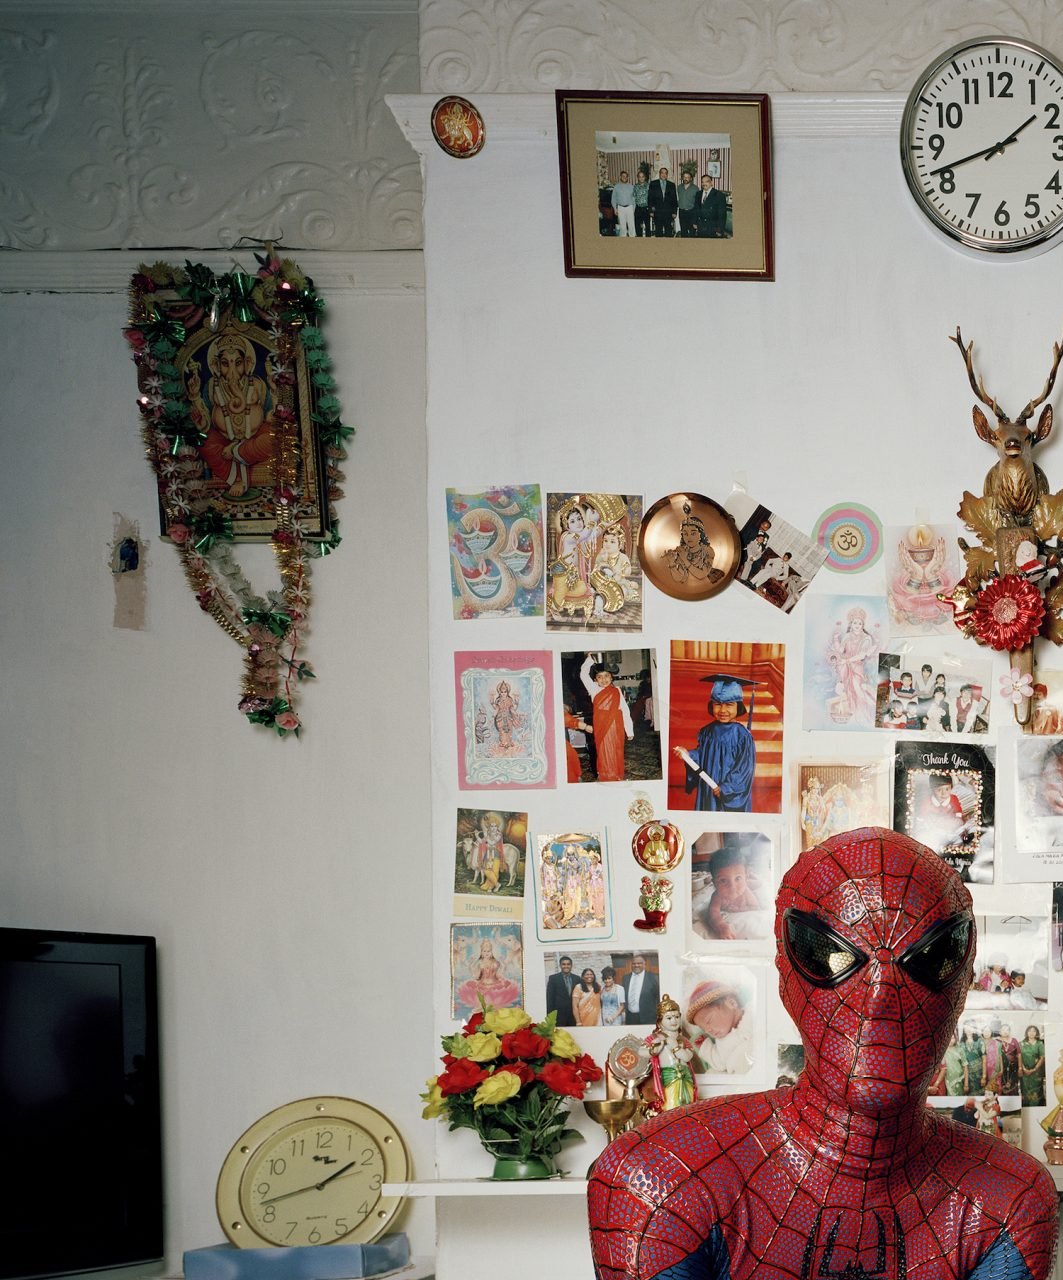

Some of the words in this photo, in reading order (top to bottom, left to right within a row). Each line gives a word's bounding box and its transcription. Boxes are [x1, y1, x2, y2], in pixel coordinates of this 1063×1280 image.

[962, 78, 980, 105] 11
[986, 71, 1014, 98] 12
[1028, 78, 1036, 105] 1
[935, 102, 963, 129] 10
[1043, 103, 1061, 129] 2
[928, 133, 945, 161] 9
[939, 168, 956, 194] 8
[1044, 169, 1062, 195] 4
[965, 193, 982, 218] 7
[994, 200, 1010, 227] 6
[1023, 193, 1040, 219] 5
[921, 752, 949, 766] Thank
[952, 753, 969, 769] You
[291, 1139, 305, 1157] 11
[316, 1130, 334, 1148] 12
[347, 1134, 352, 1152] 1
[360, 1148, 375, 1166] 2
[269, 1158, 287, 1176] 10
[257, 1182, 270, 1199] 9
[369, 1174, 382, 1191] 3
[262, 1205, 276, 1223] 8
[357, 1200, 369, 1216] 4
[285, 1222, 298, 1239] 7
[308, 1226, 321, 1244] 6
[334, 1218, 349, 1236] 5
